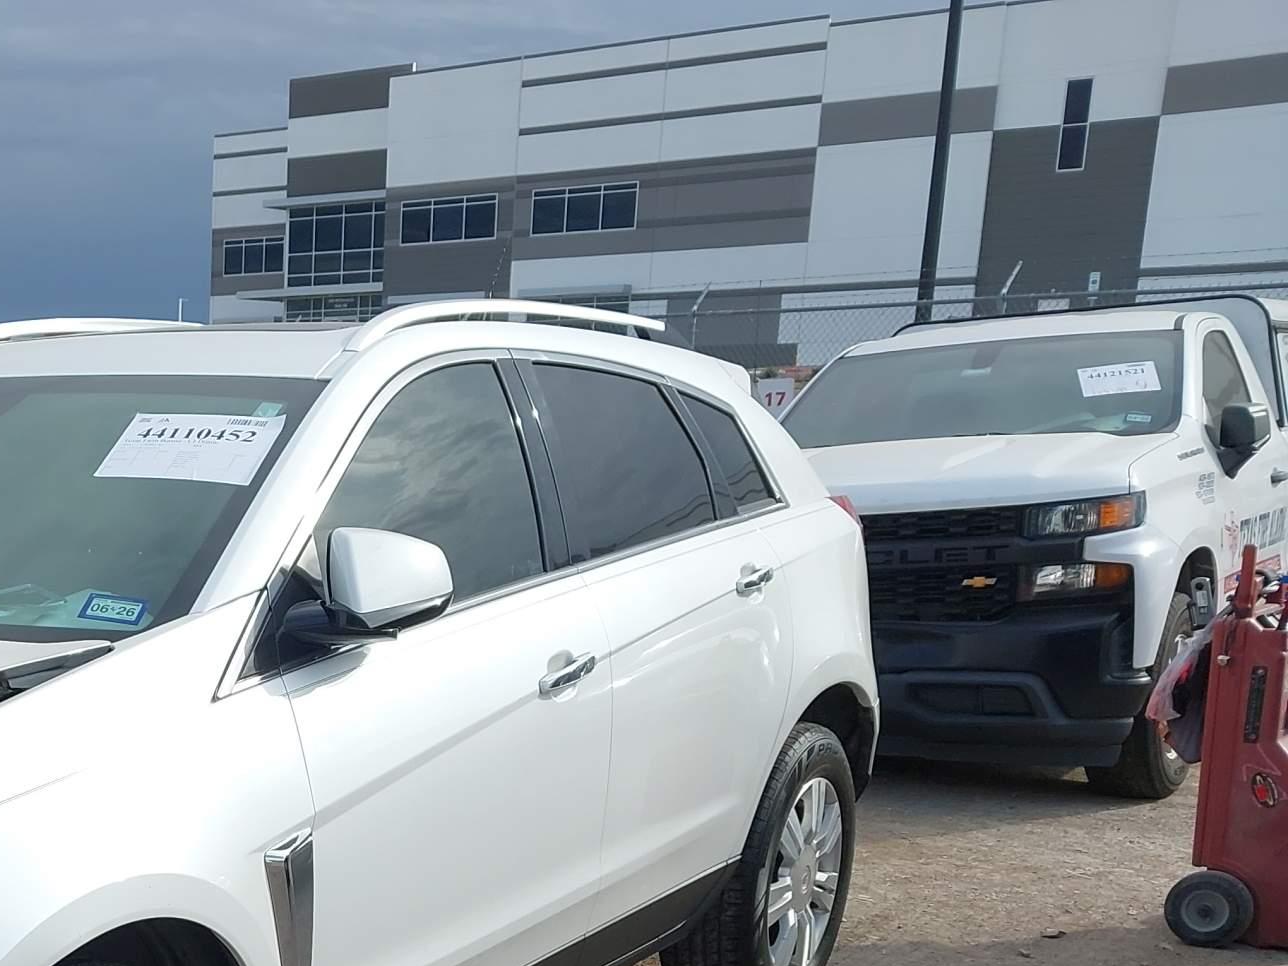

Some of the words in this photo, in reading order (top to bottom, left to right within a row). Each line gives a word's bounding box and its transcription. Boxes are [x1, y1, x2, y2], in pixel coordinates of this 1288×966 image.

[764, 391, 786, 407] 17
[137, 427, 257, 443] 44110452
[90, 603, 110, 614] 06
[115, 606, 136, 617] 26
